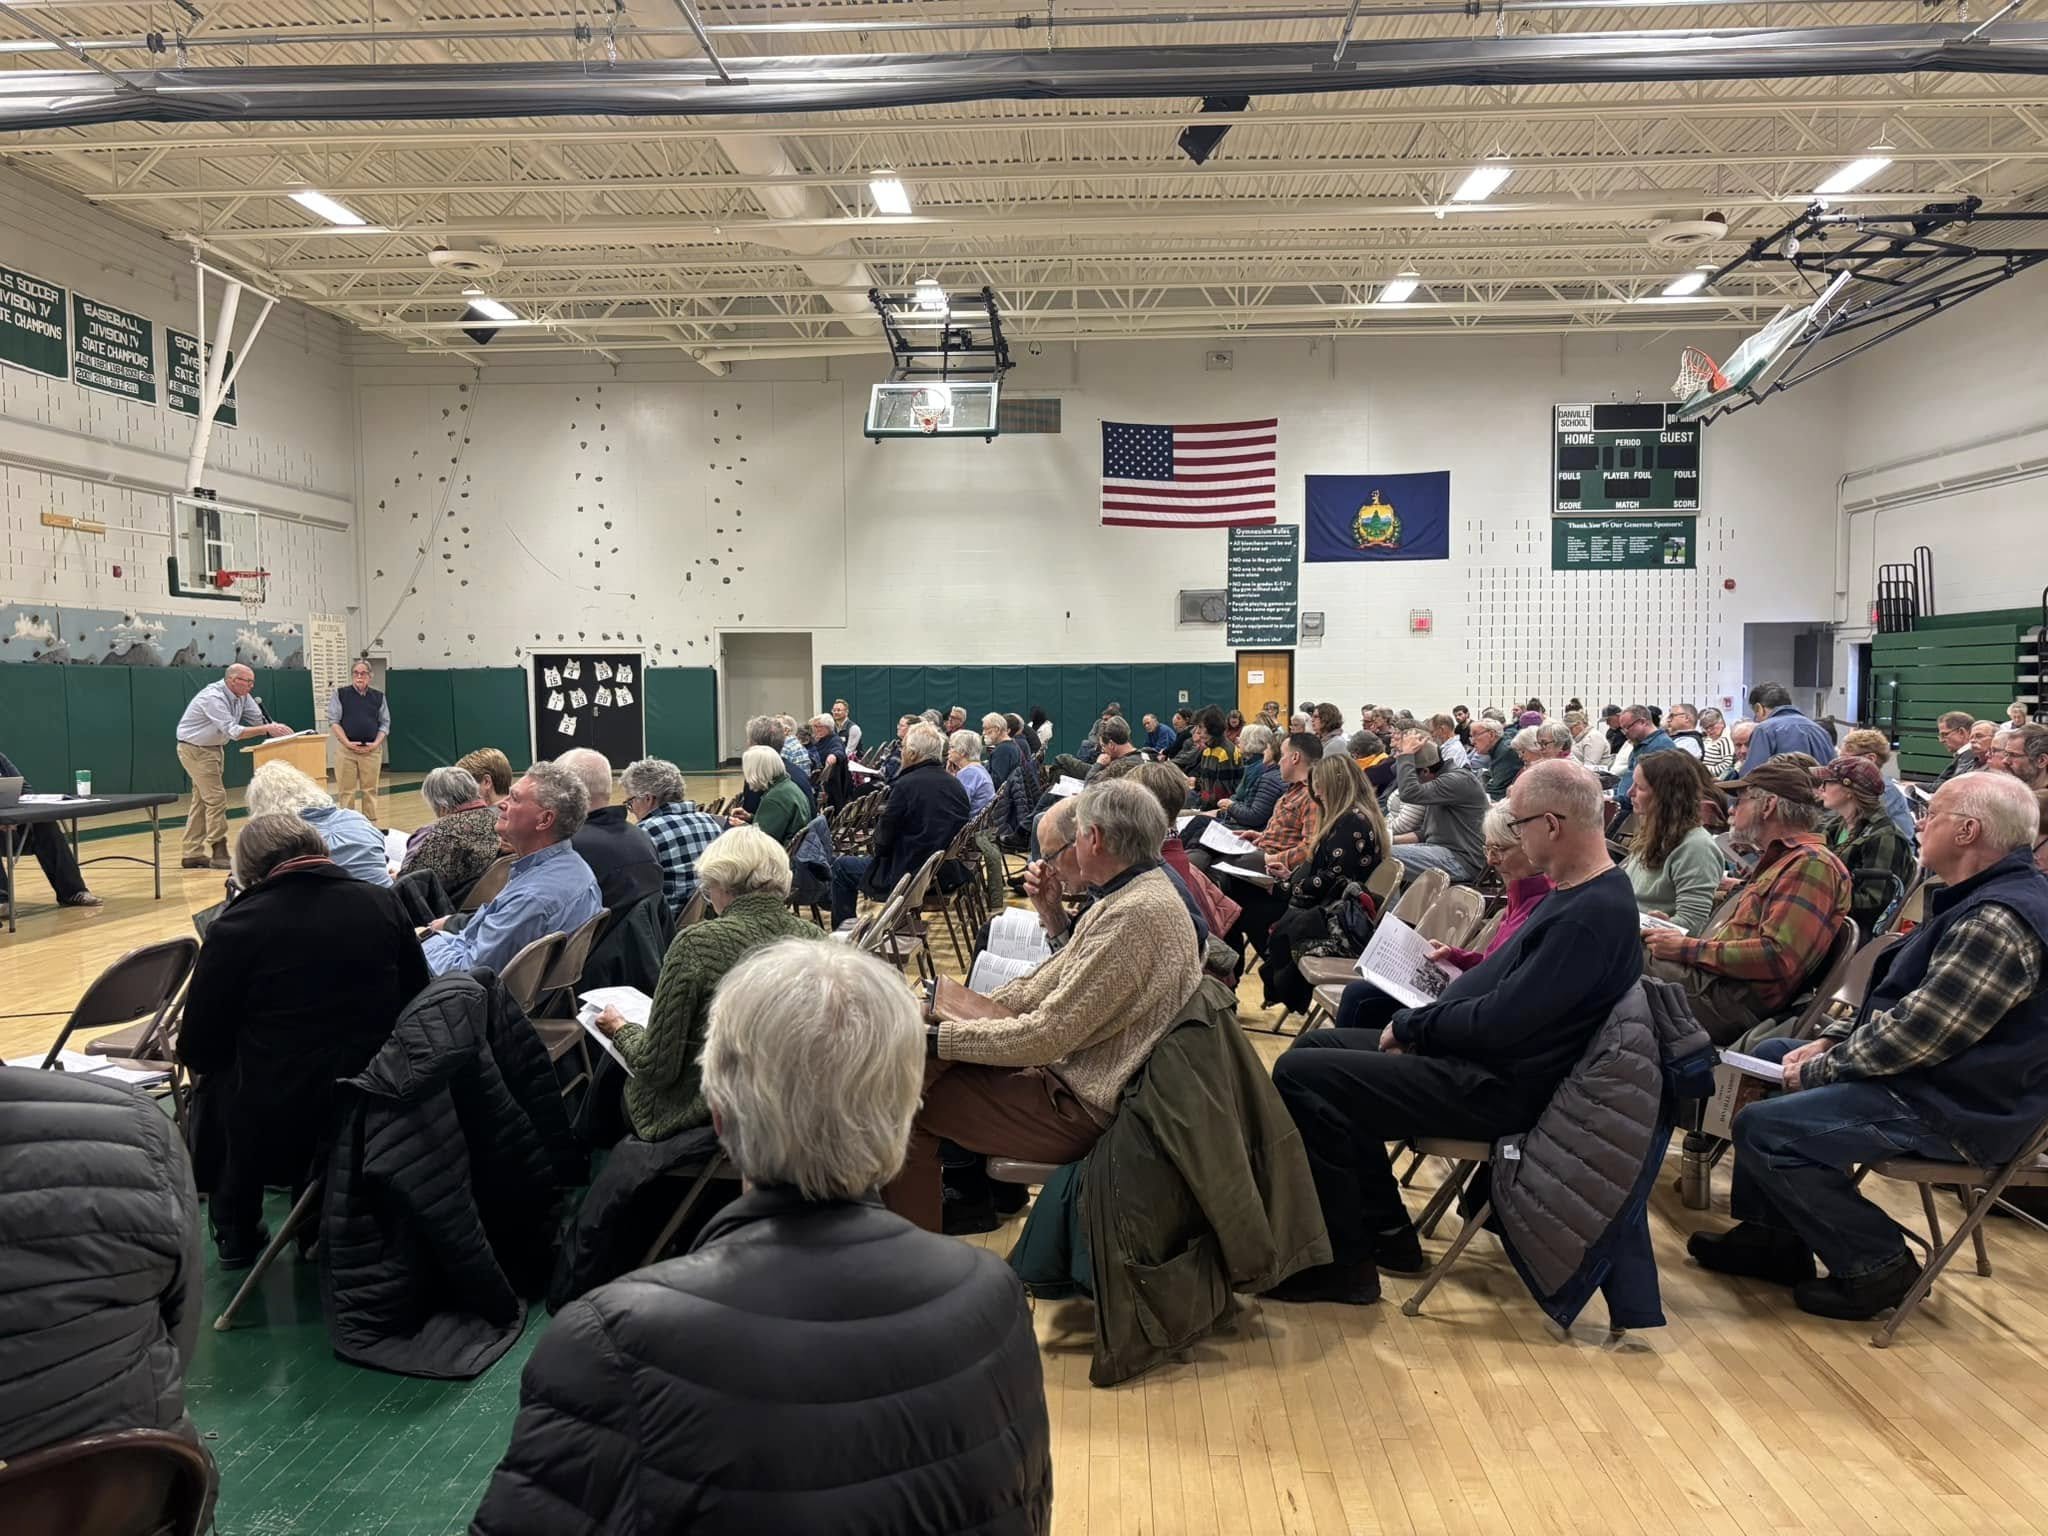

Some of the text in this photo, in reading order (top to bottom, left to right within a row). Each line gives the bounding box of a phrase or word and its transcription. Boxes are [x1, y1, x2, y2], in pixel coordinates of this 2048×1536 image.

[16, 276, 59, 304] SOCCER
[40, 302, 52, 318] IV
[83, 302, 143, 334] BASEBALL
[89, 321, 140, 348] DIVISION IV
[82, 336, 149, 368] STATE CHAMPIONS
[1558, 410, 1590, 418] DANVILLE
[1560, 419, 1588, 427] SCHOOL
[1565, 434, 1595, 444] HOME
[1660, 432, 1694, 442] GUEST
[1558, 472, 1581, 480] FOULS
[1603, 471, 1652, 480] PLAYER FOUL
[1674, 470, 1696, 478] FOULS
[1236, 528, 1272, 536] Gymnasium
[550, 676, 559, 686] 15
[598, 694, 608, 704] 20
